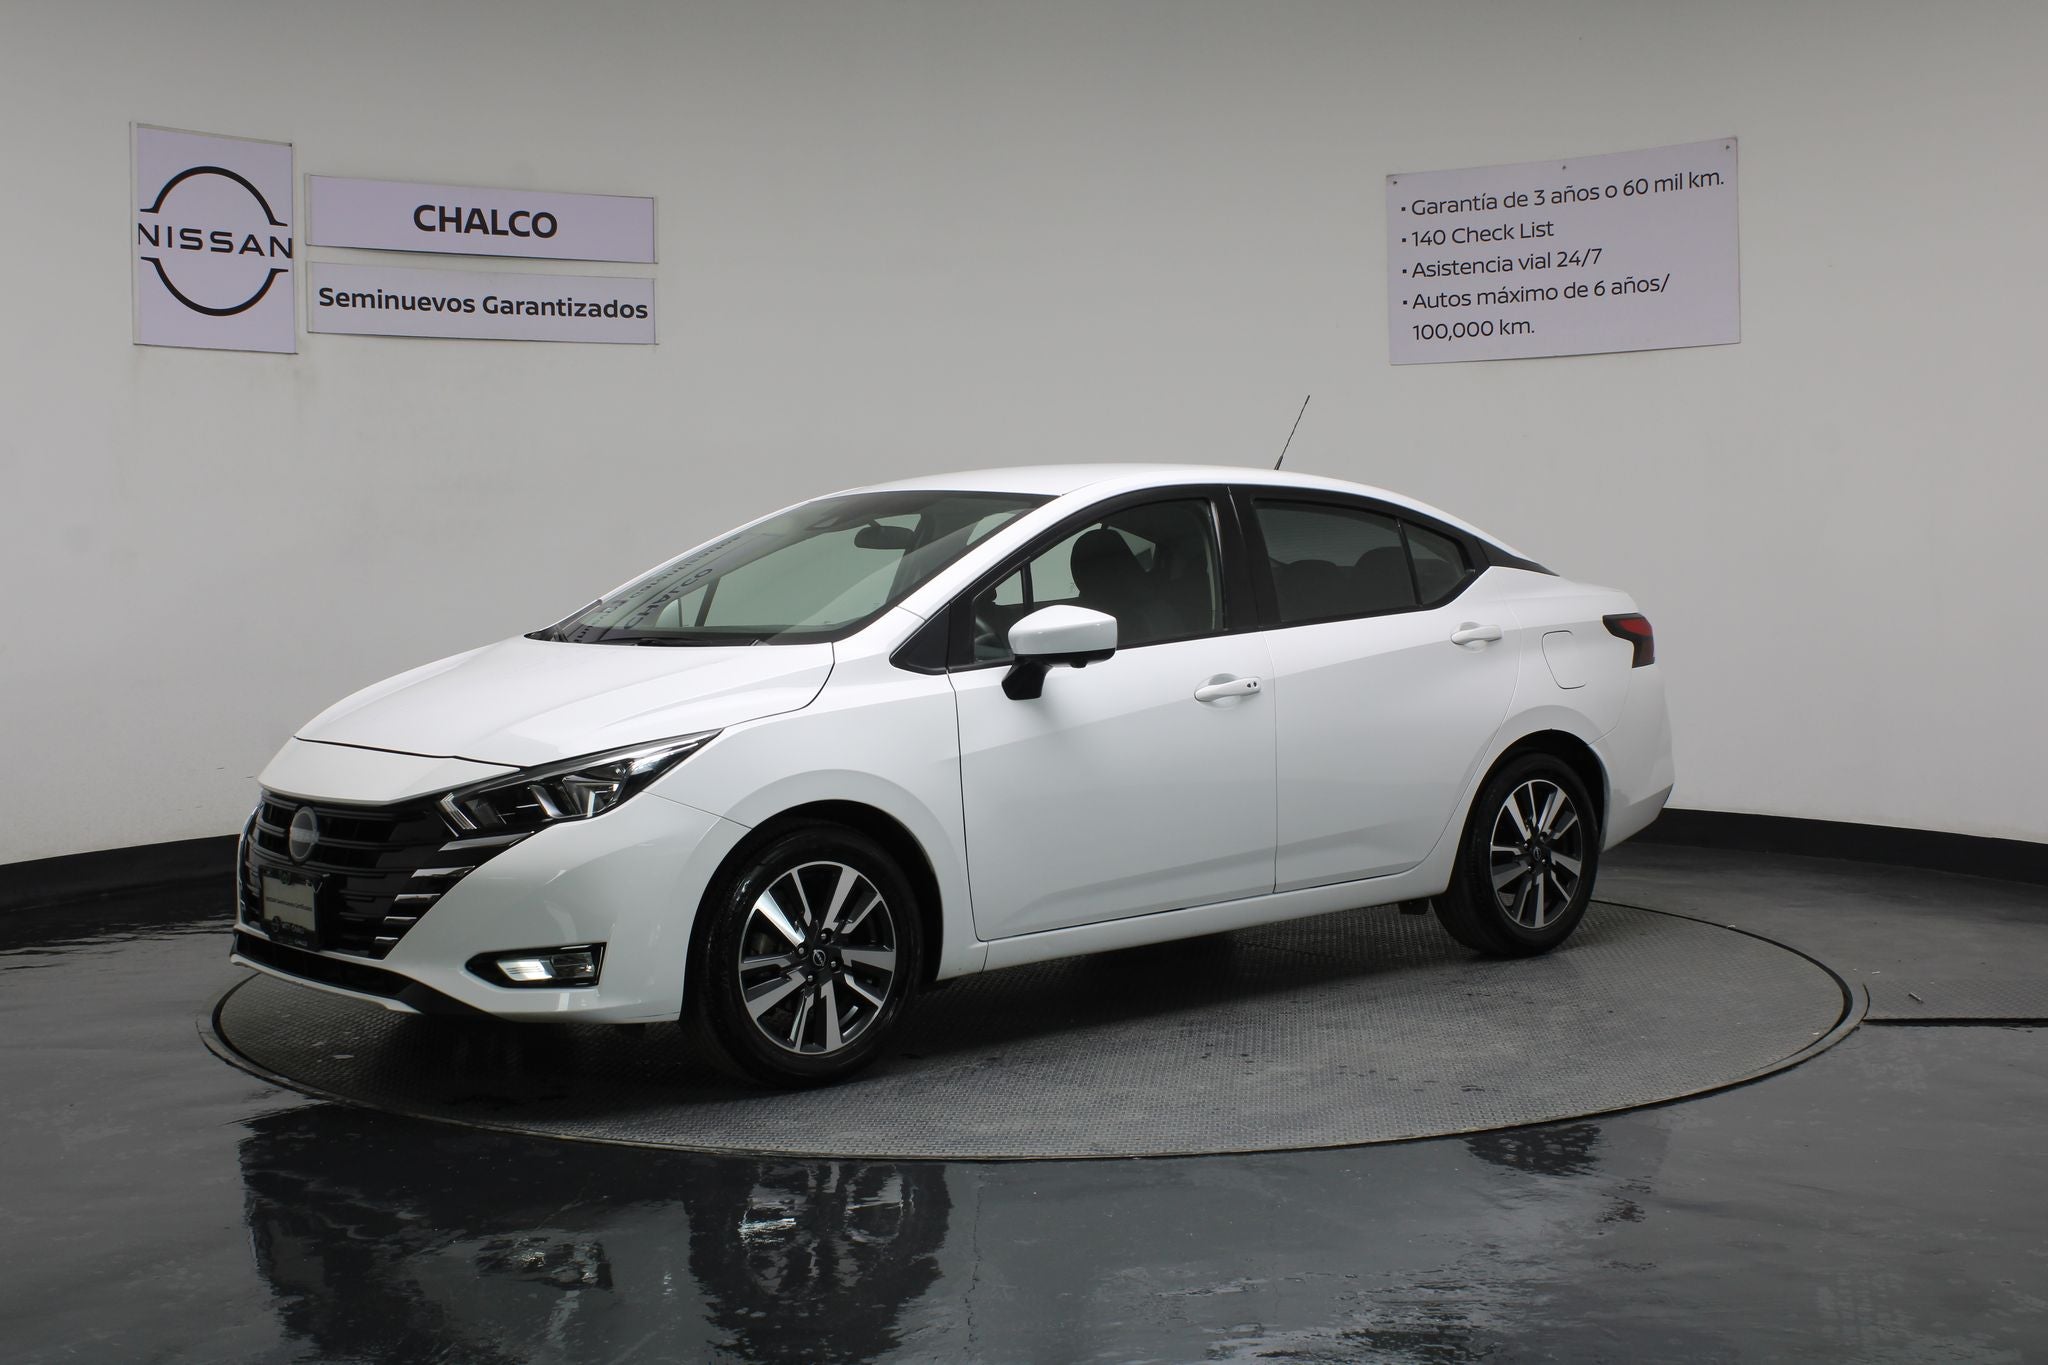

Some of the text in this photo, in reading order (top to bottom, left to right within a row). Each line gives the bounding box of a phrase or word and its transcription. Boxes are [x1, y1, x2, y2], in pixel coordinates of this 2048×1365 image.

[1411, 171, 1725, 216] Garantía de 3 años o 60 mil km.
[413, 204, 558, 239] CHALCO
[1411, 220, 1555, 247] 140 Check List
[137, 222, 293, 259] NISSAN
[1411, 247, 1603, 279] Asistencia vial 24/7
[318, 287, 649, 320] Seminuevos Garantizados
[1412, 273, 1671, 310] Autos máximo de 6 años/
[1412, 318, 1535, 342] 100,000 km.
